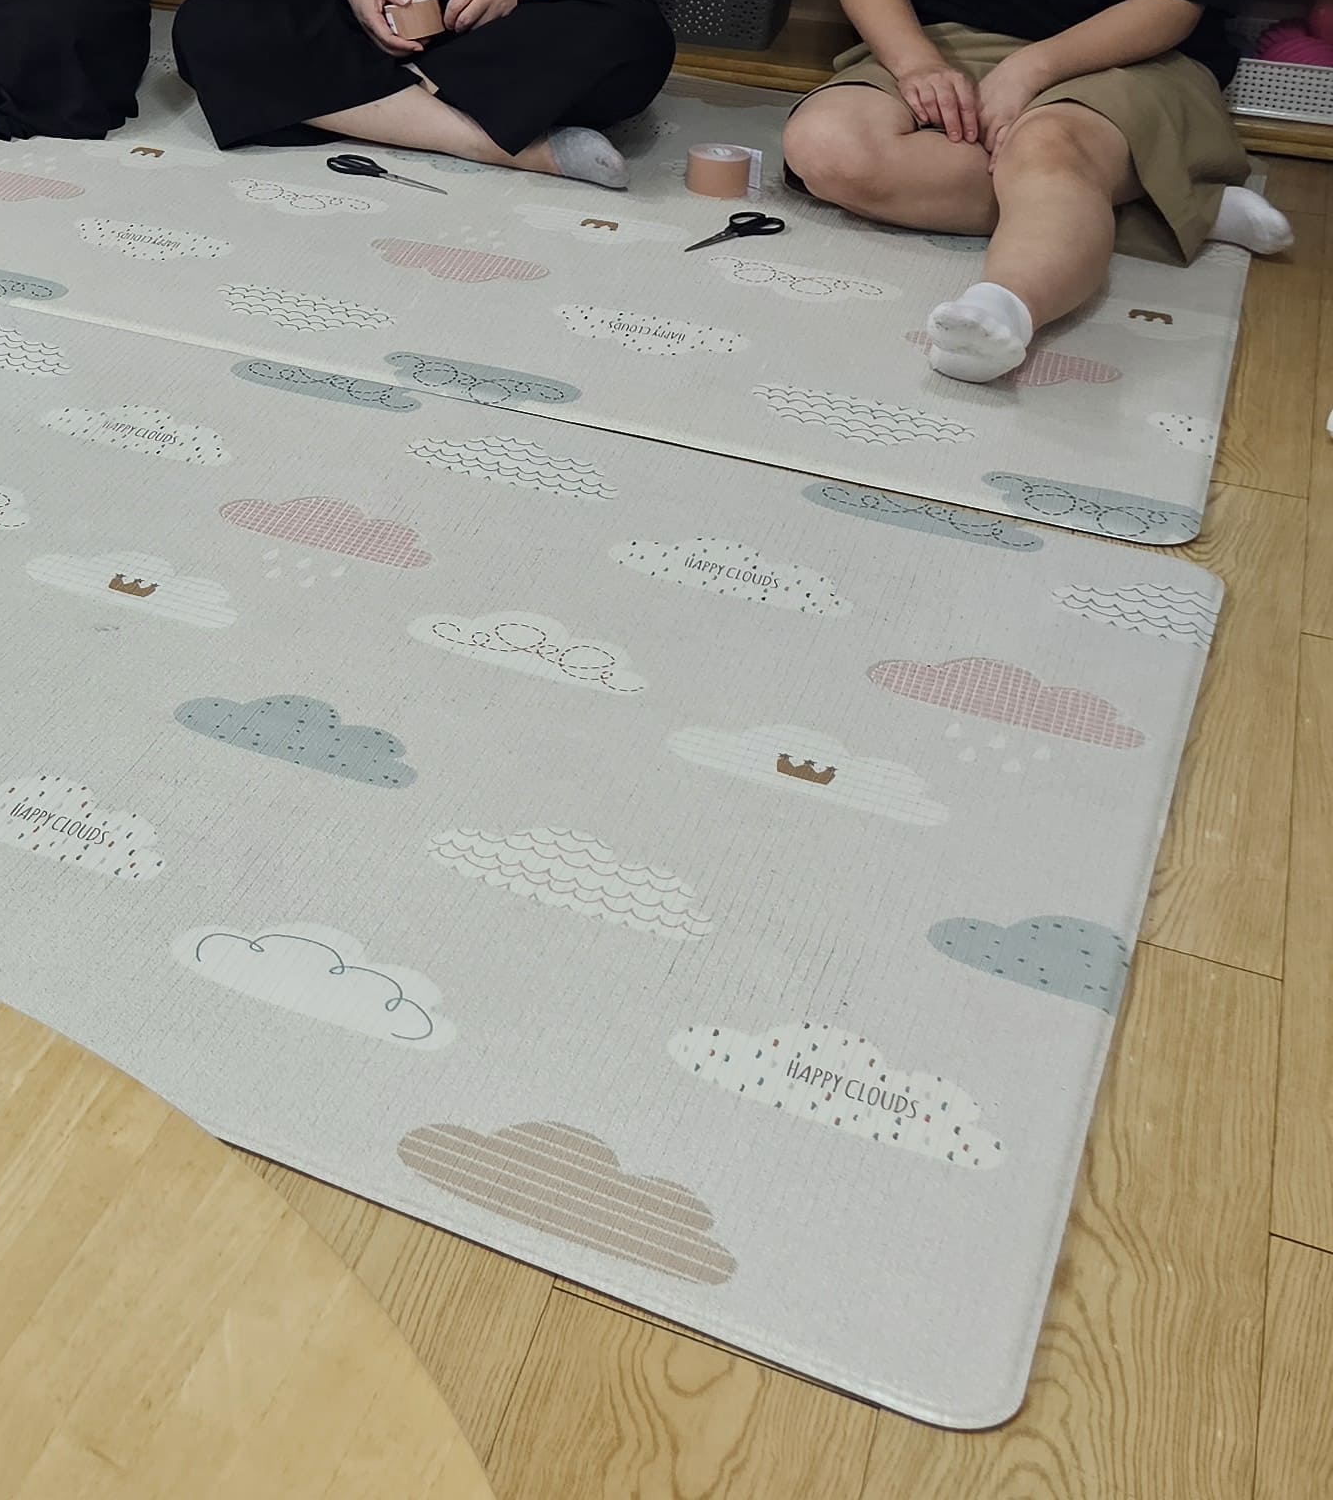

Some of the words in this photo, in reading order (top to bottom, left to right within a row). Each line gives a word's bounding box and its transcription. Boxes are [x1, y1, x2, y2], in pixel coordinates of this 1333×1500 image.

[608, 321, 651, 335] CLOUDS
[652, 328, 685, 342] HAPPY
[102, 421, 136, 435] HAPPY
[134, 428, 179, 445] CLOUDS
[684, 556, 725, 575] HAPPY
[726, 567, 779, 589] CLOUDS
[10, 802, 56, 826] HAPPY
[52, 816, 110, 845] CLOUDS
[786, 1059, 843, 1093] HAPPY
[845, 1079, 920, 1119] CLOUDS
